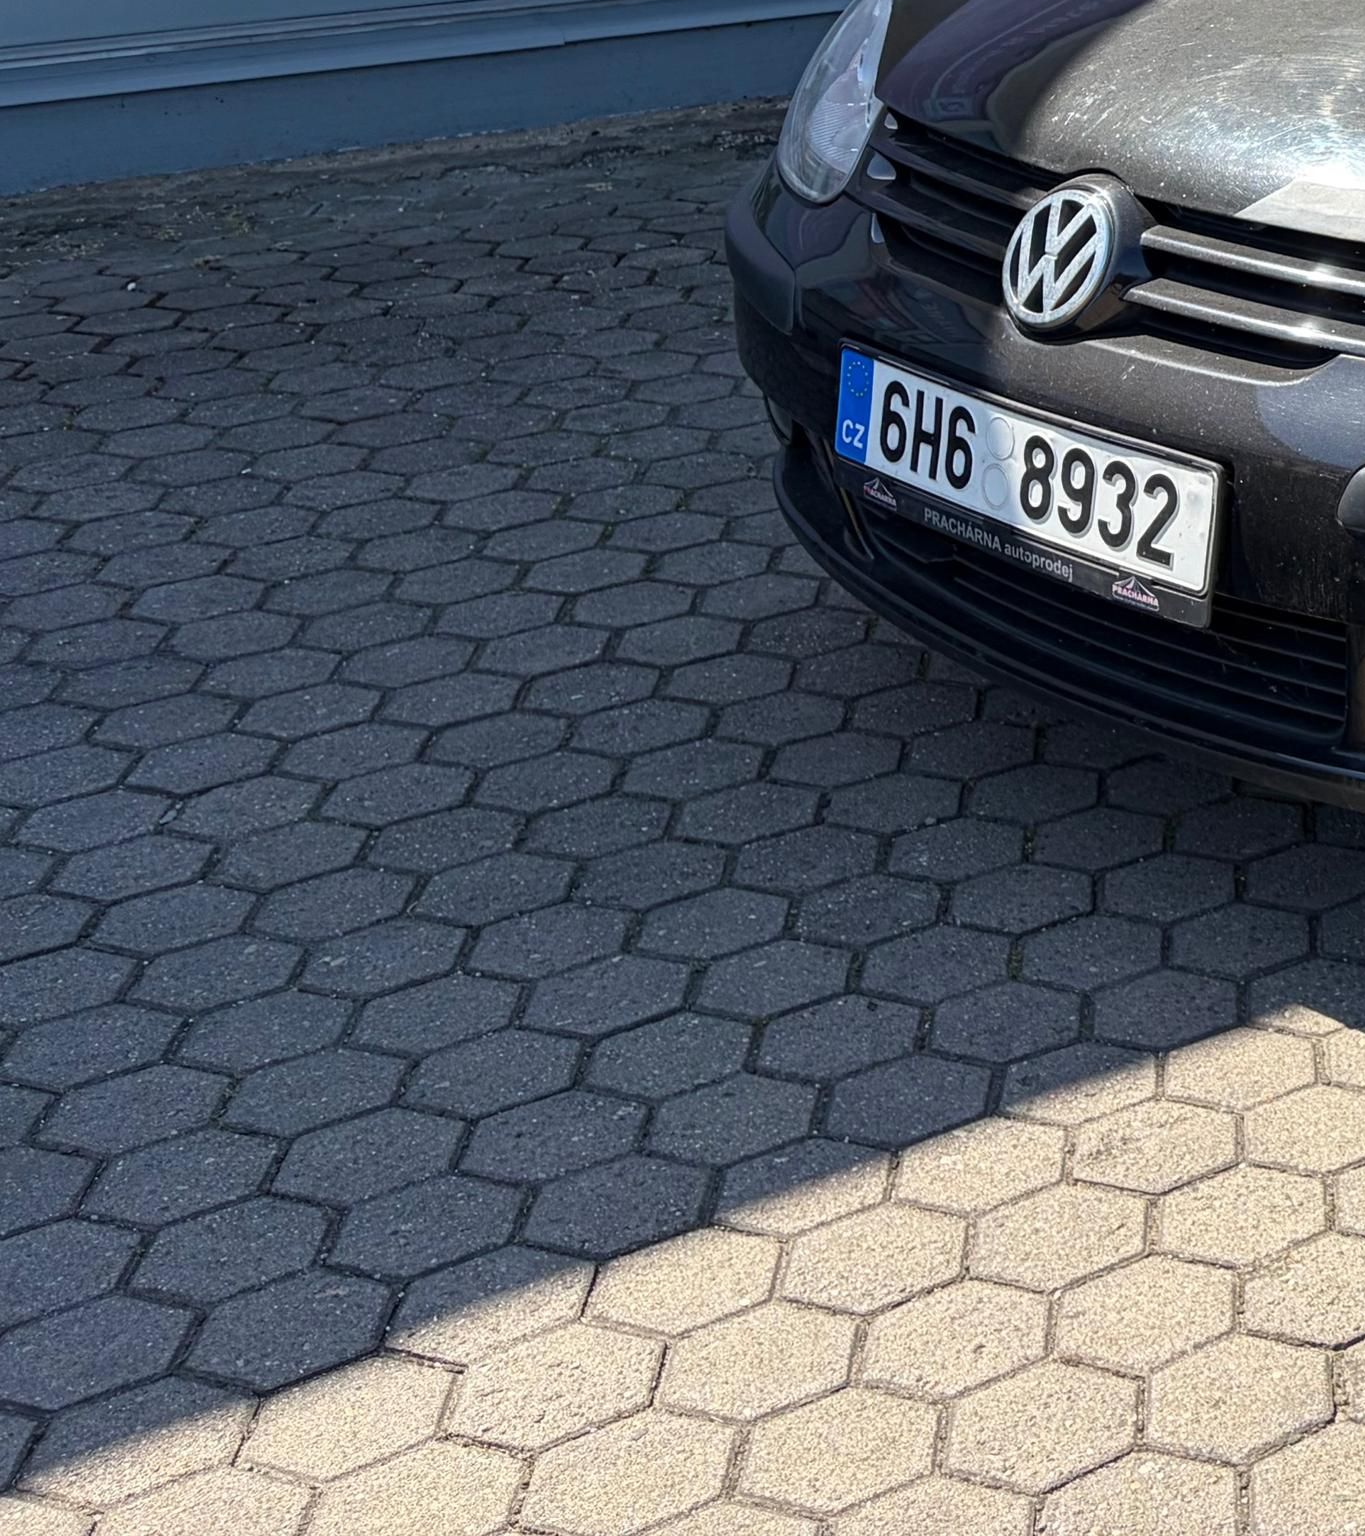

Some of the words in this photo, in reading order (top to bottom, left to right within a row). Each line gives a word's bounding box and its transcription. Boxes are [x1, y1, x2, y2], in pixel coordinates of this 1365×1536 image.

[841, 418, 864, 450] CZ
[879, 380, 976, 490] 6H6
[1020, 435, 1179, 567] 8932
[924, 507, 1002, 553] PRACHÁRNA
[1004, 543, 1073, 583] autoprodej
